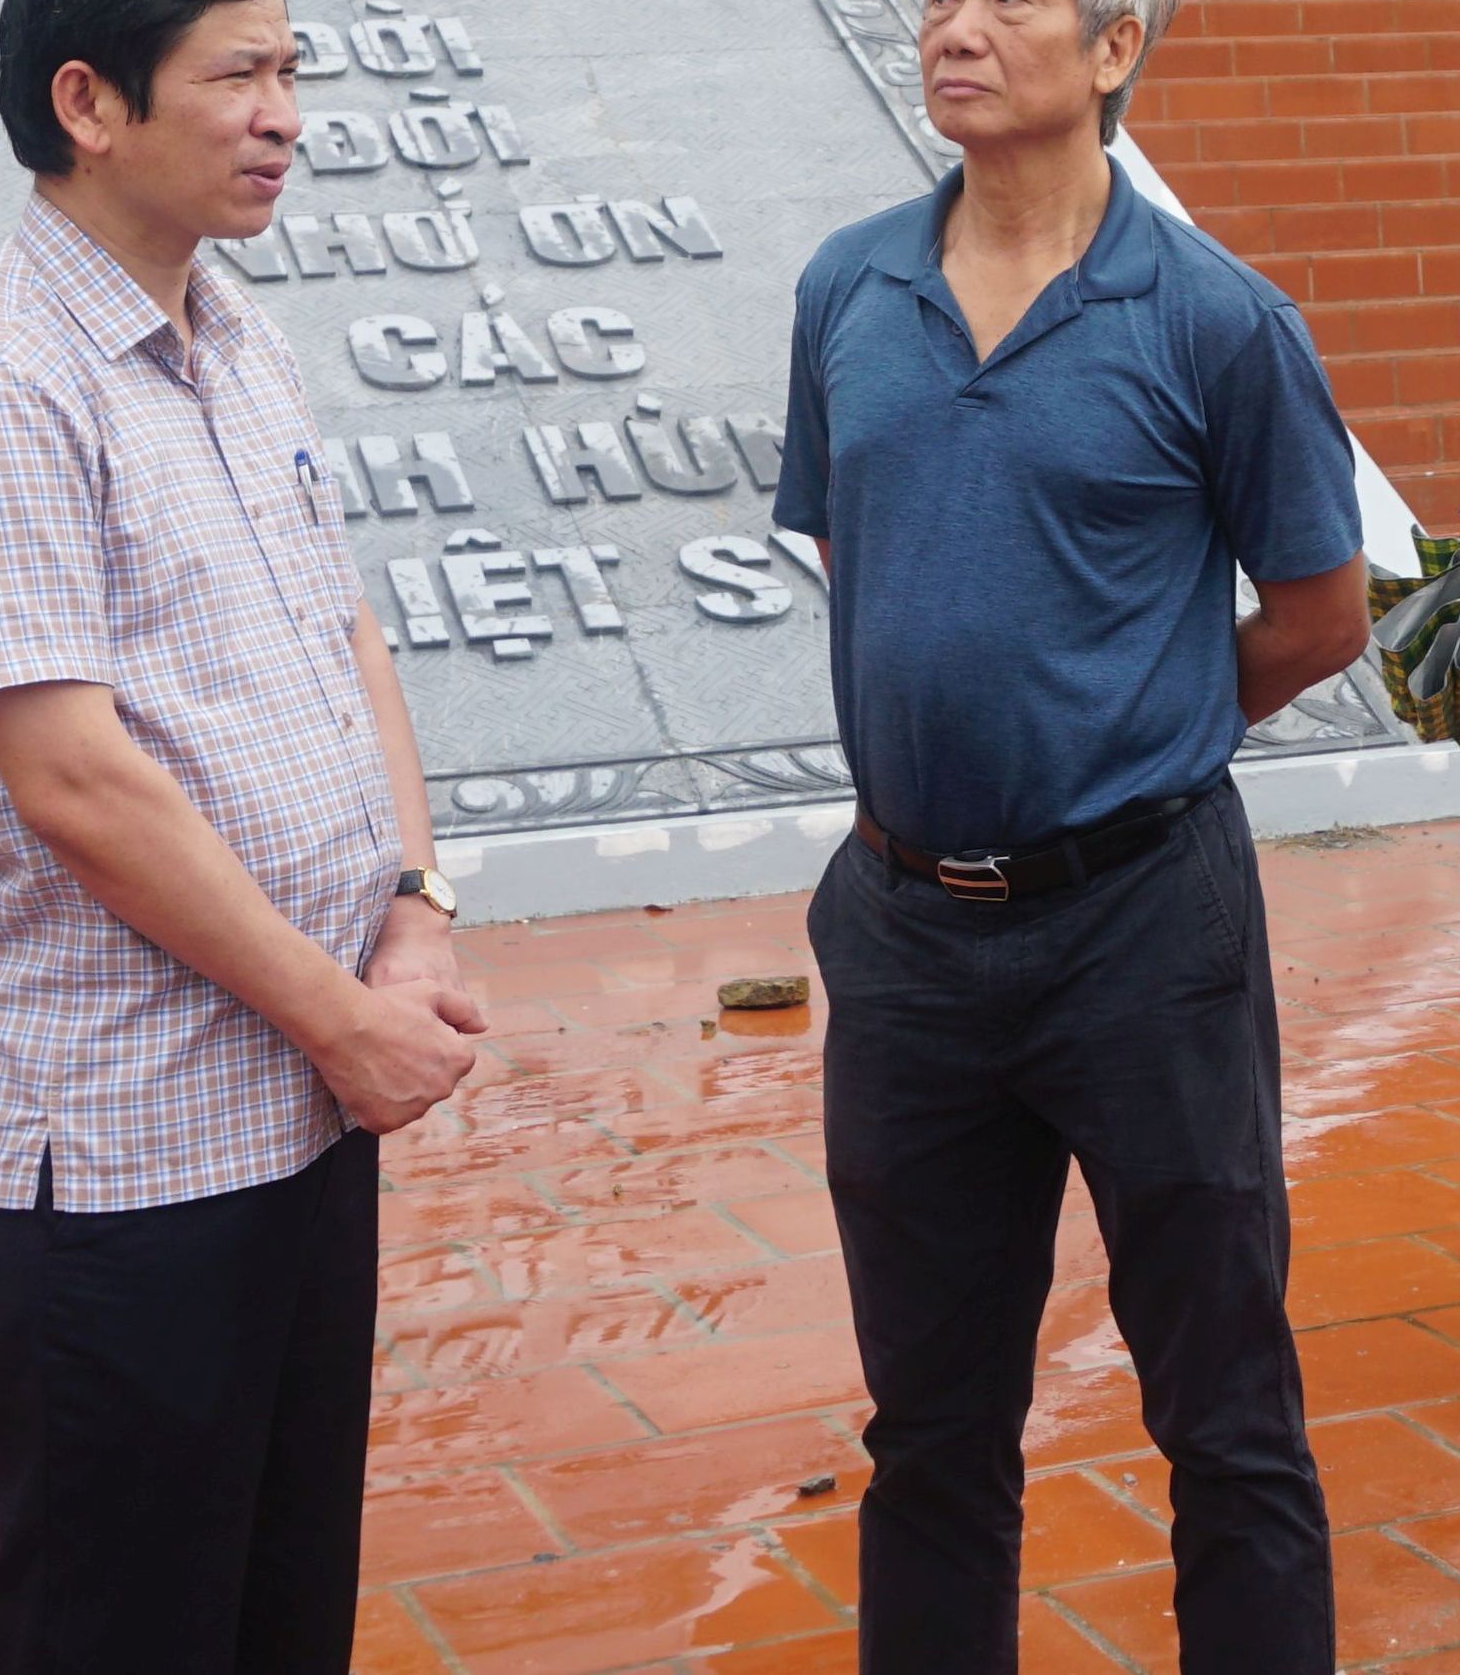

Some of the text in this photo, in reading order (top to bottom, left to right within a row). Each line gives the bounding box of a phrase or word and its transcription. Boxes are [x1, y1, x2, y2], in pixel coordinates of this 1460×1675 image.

[519, 193, 724, 267] ƠN
[348, 282, 646, 391] CÁC
[380, 528, 622, 661] IỆT
